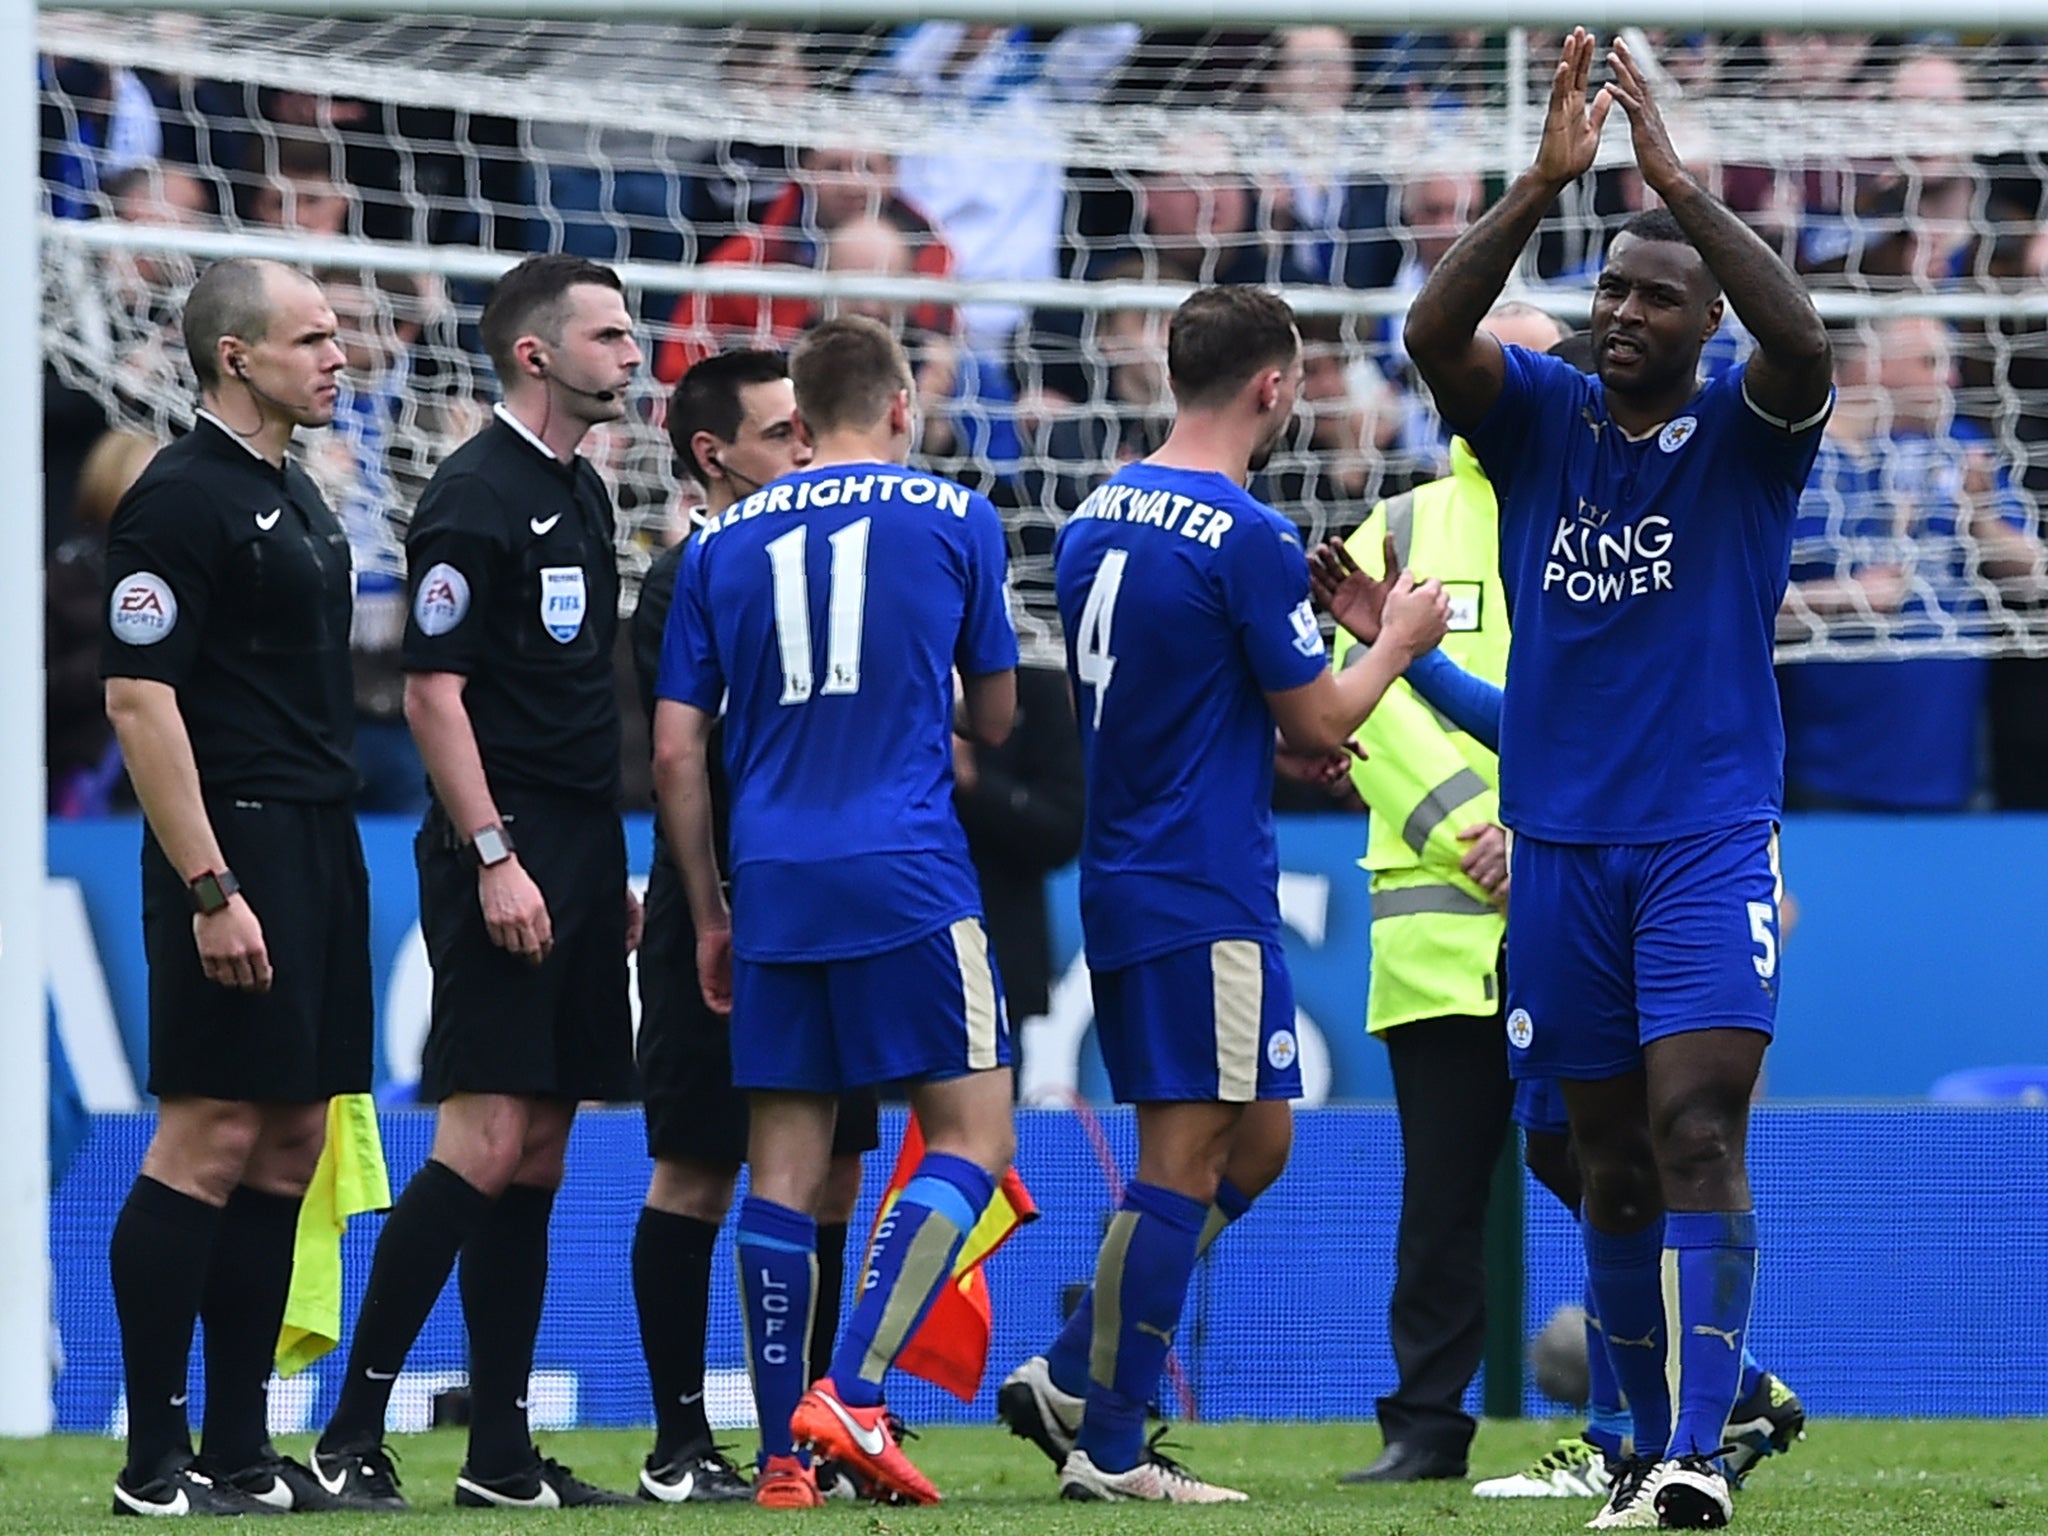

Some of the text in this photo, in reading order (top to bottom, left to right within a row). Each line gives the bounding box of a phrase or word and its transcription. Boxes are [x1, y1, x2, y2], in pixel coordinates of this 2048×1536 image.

[697, 474, 970, 546] ALBRIGHTON
[1550, 515, 1675, 568] KING
[120, 587, 164, 615] EA
[549, 596, 580, 611] FIFA
[764, 515, 872, 706] 11
[1543, 560, 1674, 604] POWER
[1076, 548, 1129, 731] 4
[1746, 901, 1777, 980] 5
[761, 1268, 790, 1364] LCFC
